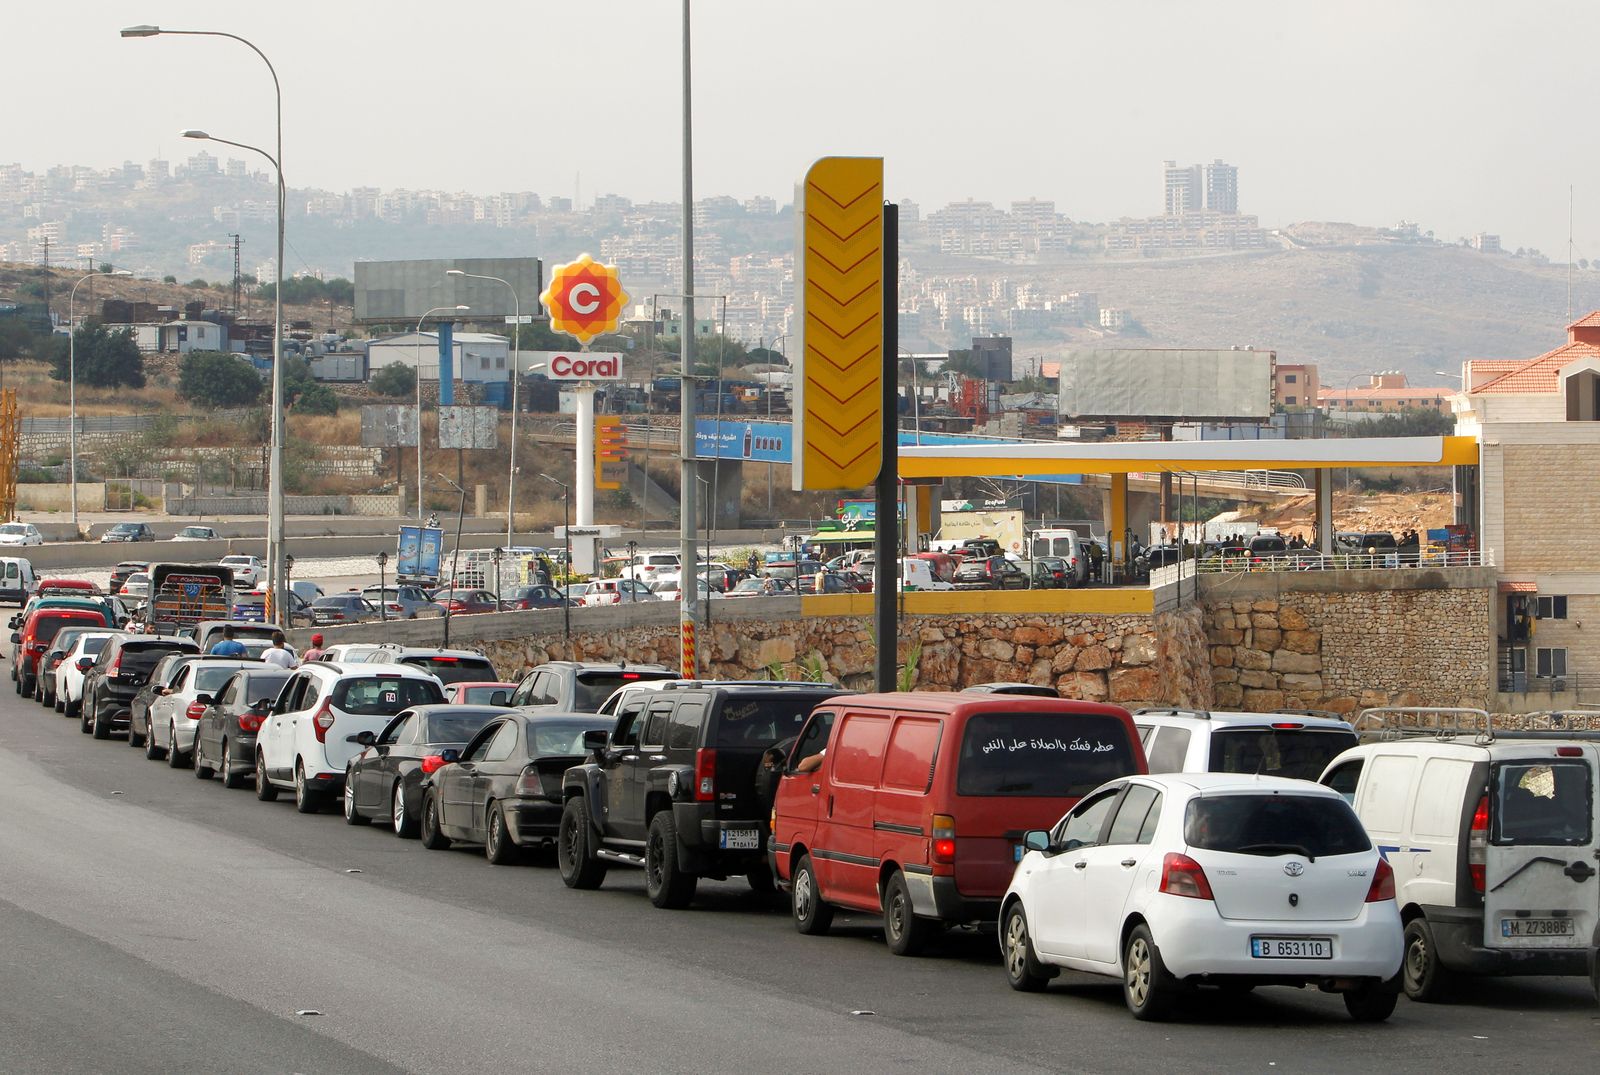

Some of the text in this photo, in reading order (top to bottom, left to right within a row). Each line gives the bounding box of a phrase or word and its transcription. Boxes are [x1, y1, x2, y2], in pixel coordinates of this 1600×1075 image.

[569, 283, 600, 315] C
[551, 356, 618, 376] Coral
[387, 693, 395, 701] 74
[982, 738, 1006, 754] النبي
[1008, 738, 1027, 752] على
[1069, 737, 1091, 751] فمك
[1092, 741, 1114, 753] عطر
[1510, 921, 1567, 934] M 273886
[1262, 941, 1322, 956] B 653110
